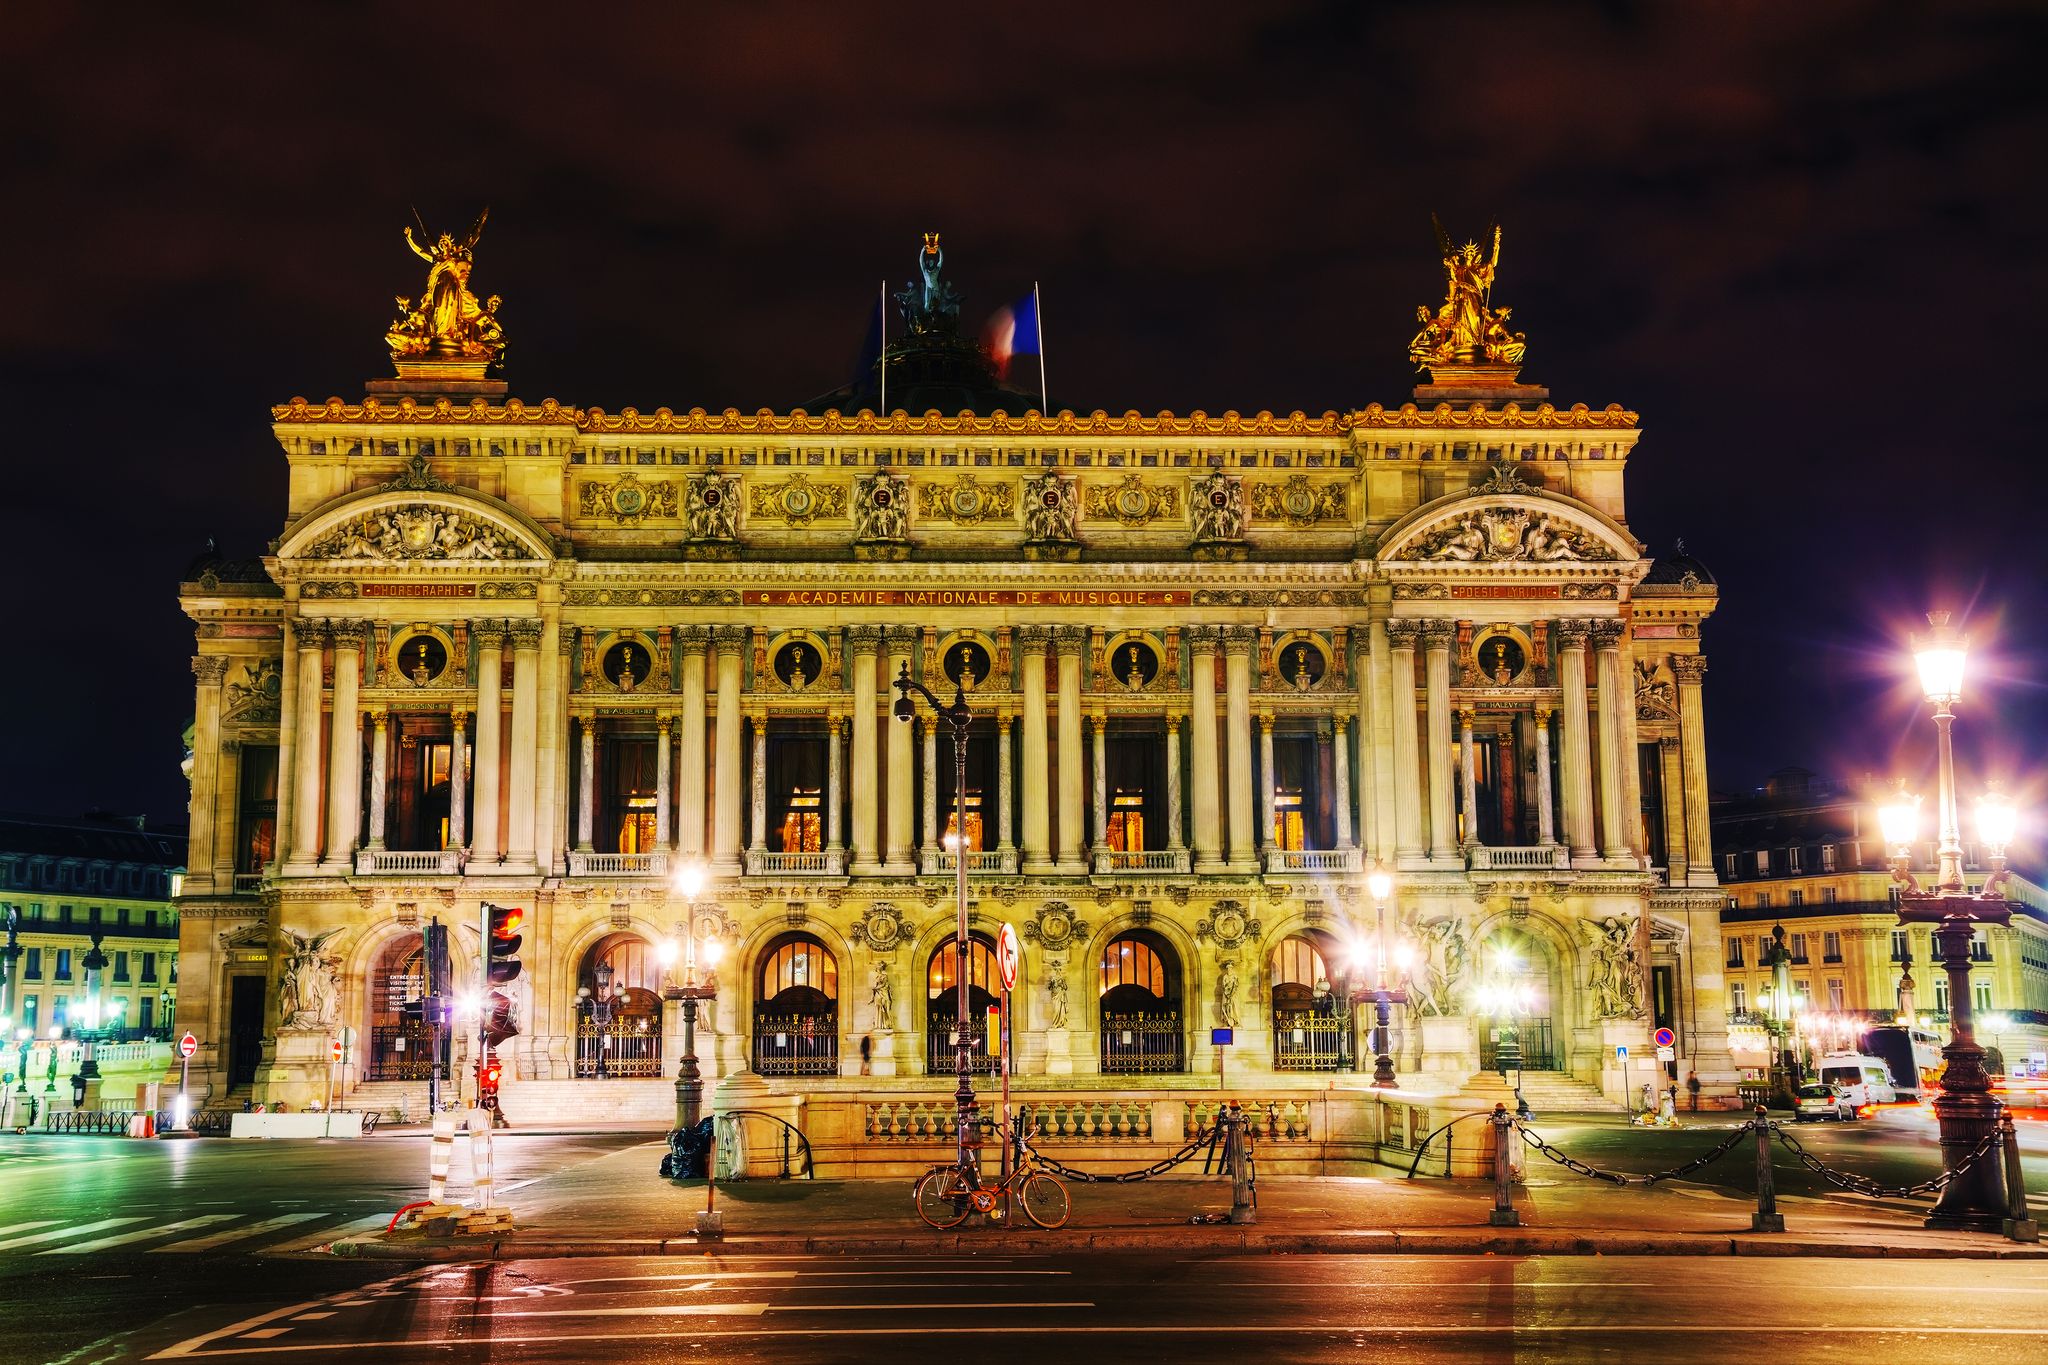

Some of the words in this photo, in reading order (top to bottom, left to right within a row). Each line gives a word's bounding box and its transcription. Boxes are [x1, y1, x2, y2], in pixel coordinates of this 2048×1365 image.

[708, 492, 716, 503] E
[879, 492, 887, 503] E
[1047, 494, 1055, 504] E
[1214, 494, 1223, 504] E
[373, 585, 465, 596] CHOREGRAPHIE
[1459, 587, 1500, 598] POESIE
[1507, 587, 1553, 598] LYRIQUE
[787, 591, 886, 604] ACADEMIE
[904, 591, 998, 604] NATIONALE
[1016, 591, 1040, 604] DE
[1060, 591, 1147, 604] MUSIQUE
